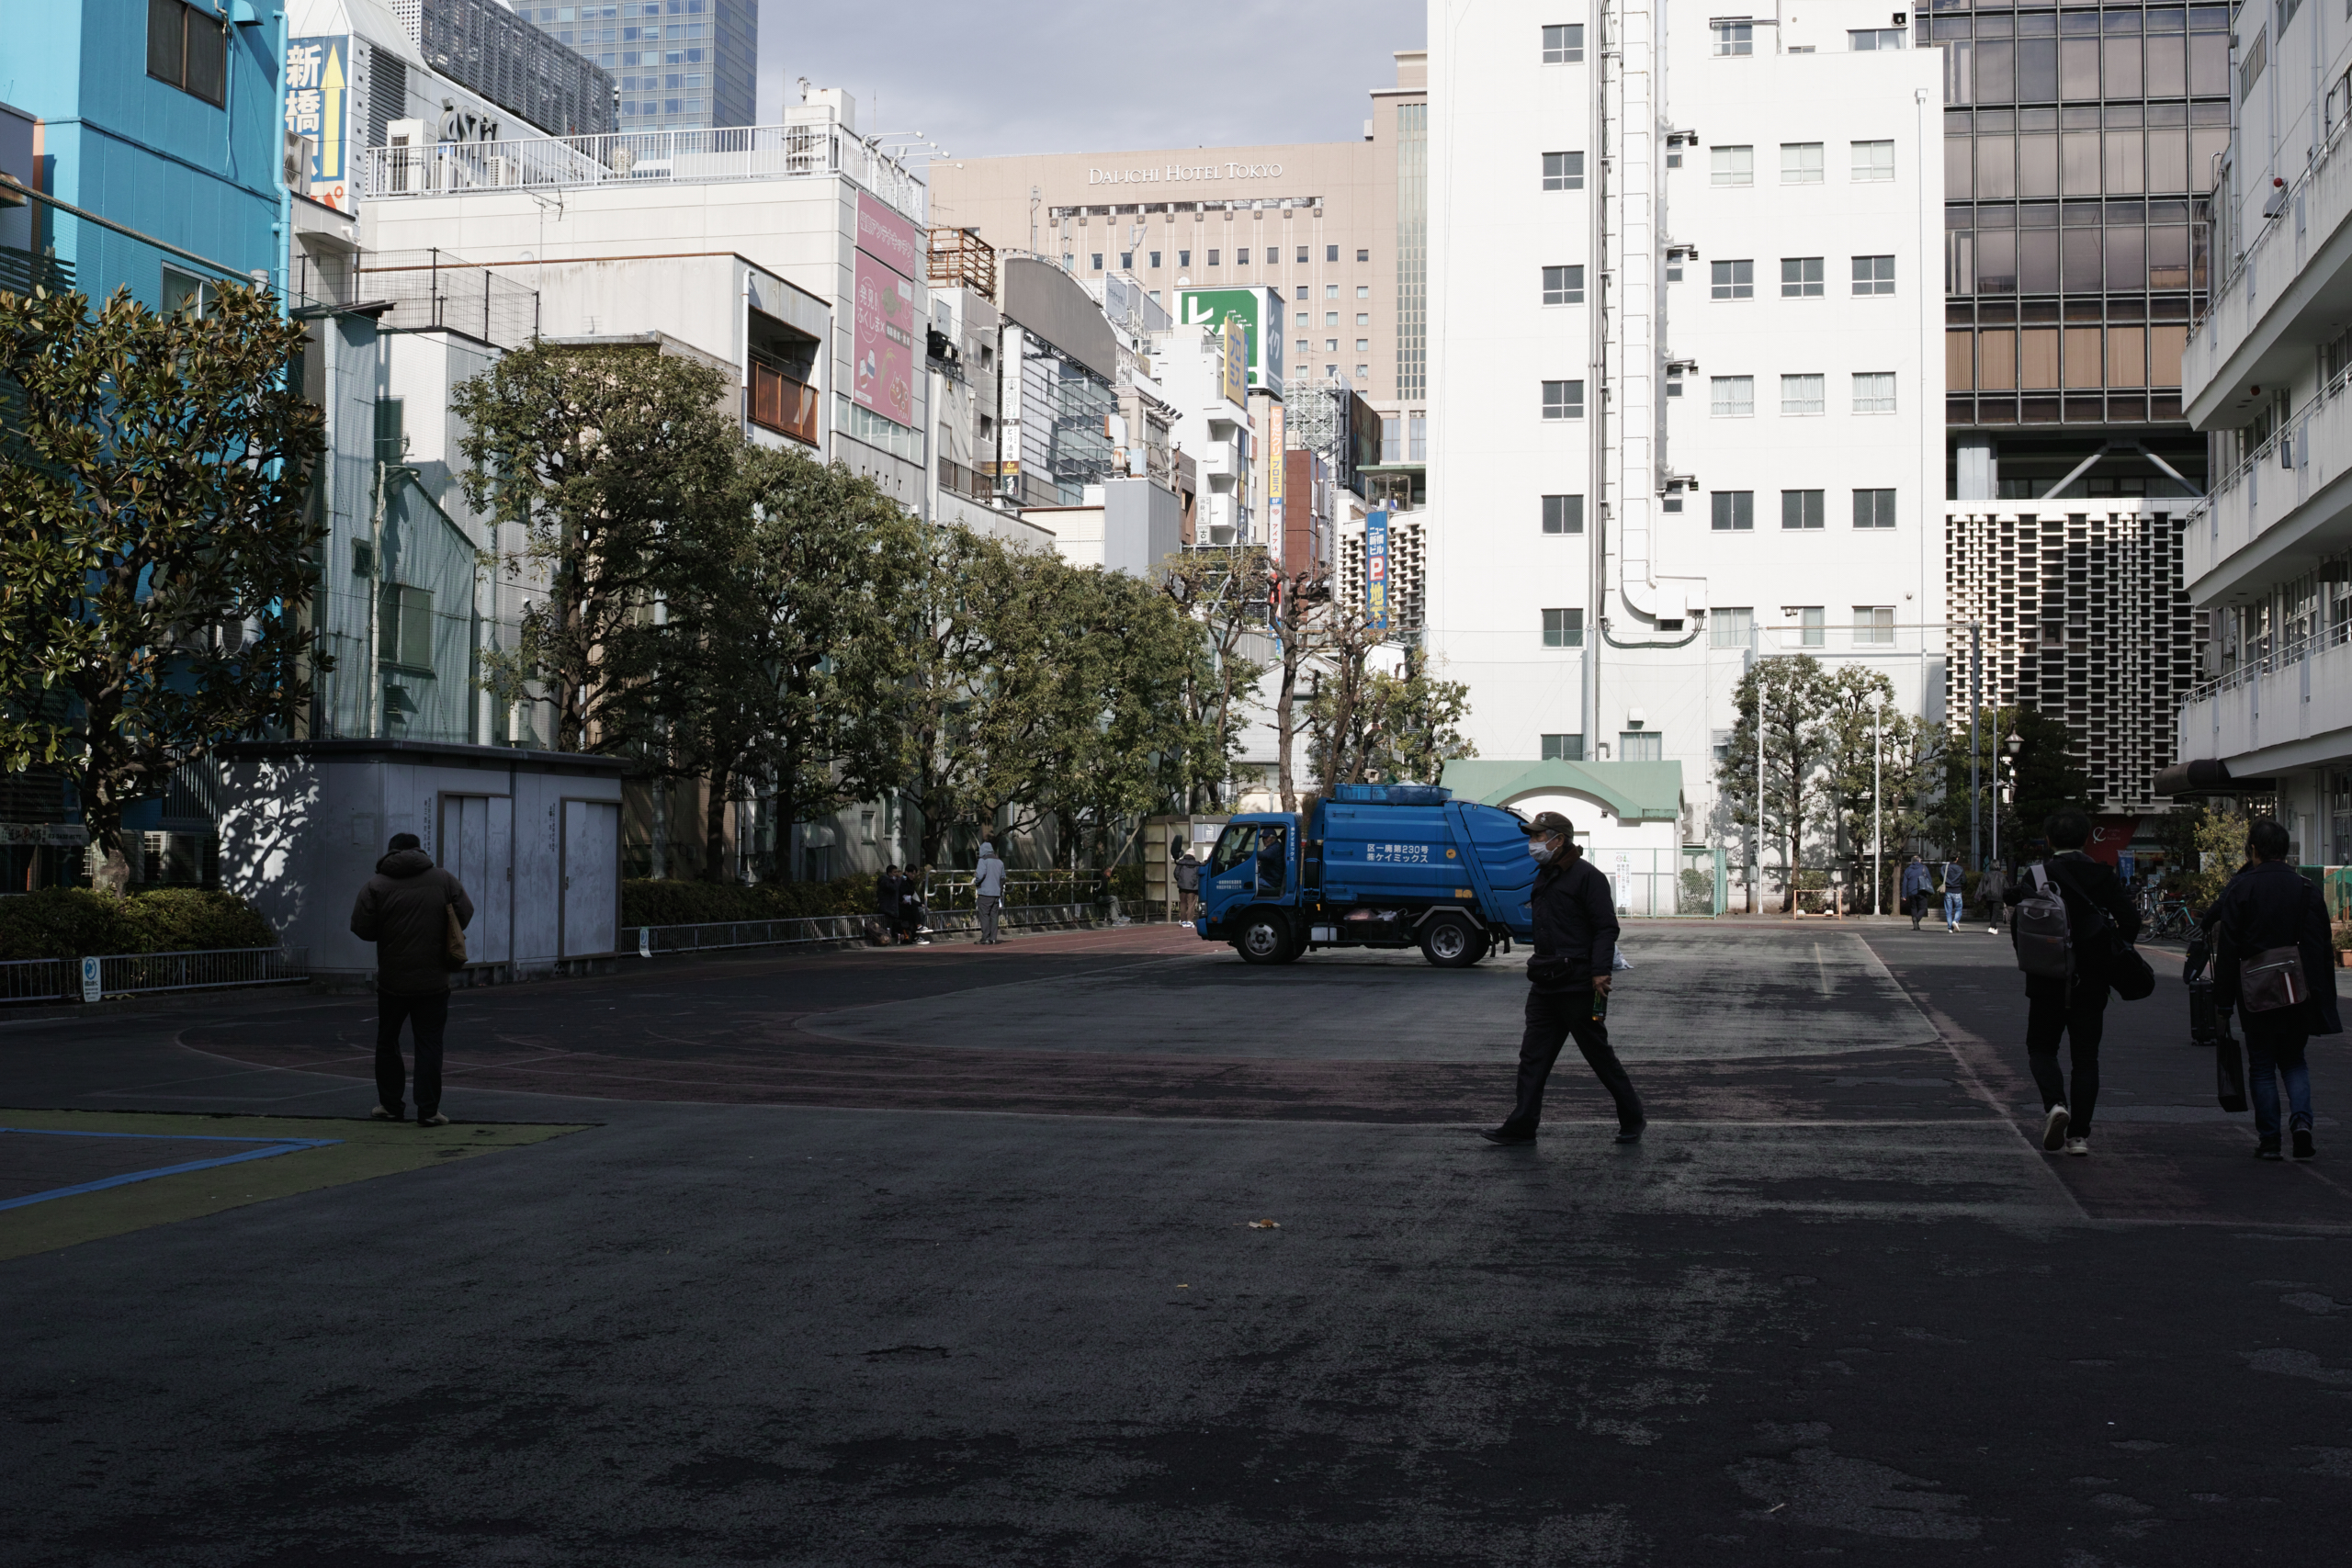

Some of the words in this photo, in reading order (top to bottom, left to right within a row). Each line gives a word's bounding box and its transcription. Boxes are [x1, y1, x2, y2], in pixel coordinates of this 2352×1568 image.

[284, 43, 322, 176] 新橋
[1089, 168, 1159, 185] DAI-ICHI
[1165, 165, 1222, 181] HOTEL
[1225, 163, 1283, 179] TOKYO
[1272, 460, 1281, 492] プロミス
[1369, 526, 1385, 536] ニュー
[1369, 535, 1385, 546] 新橋
[1370, 545, 1384, 555] ビル
[1370, 558, 1384, 581] P
[1367, 843, 1429, 854] 区一廃第230号
